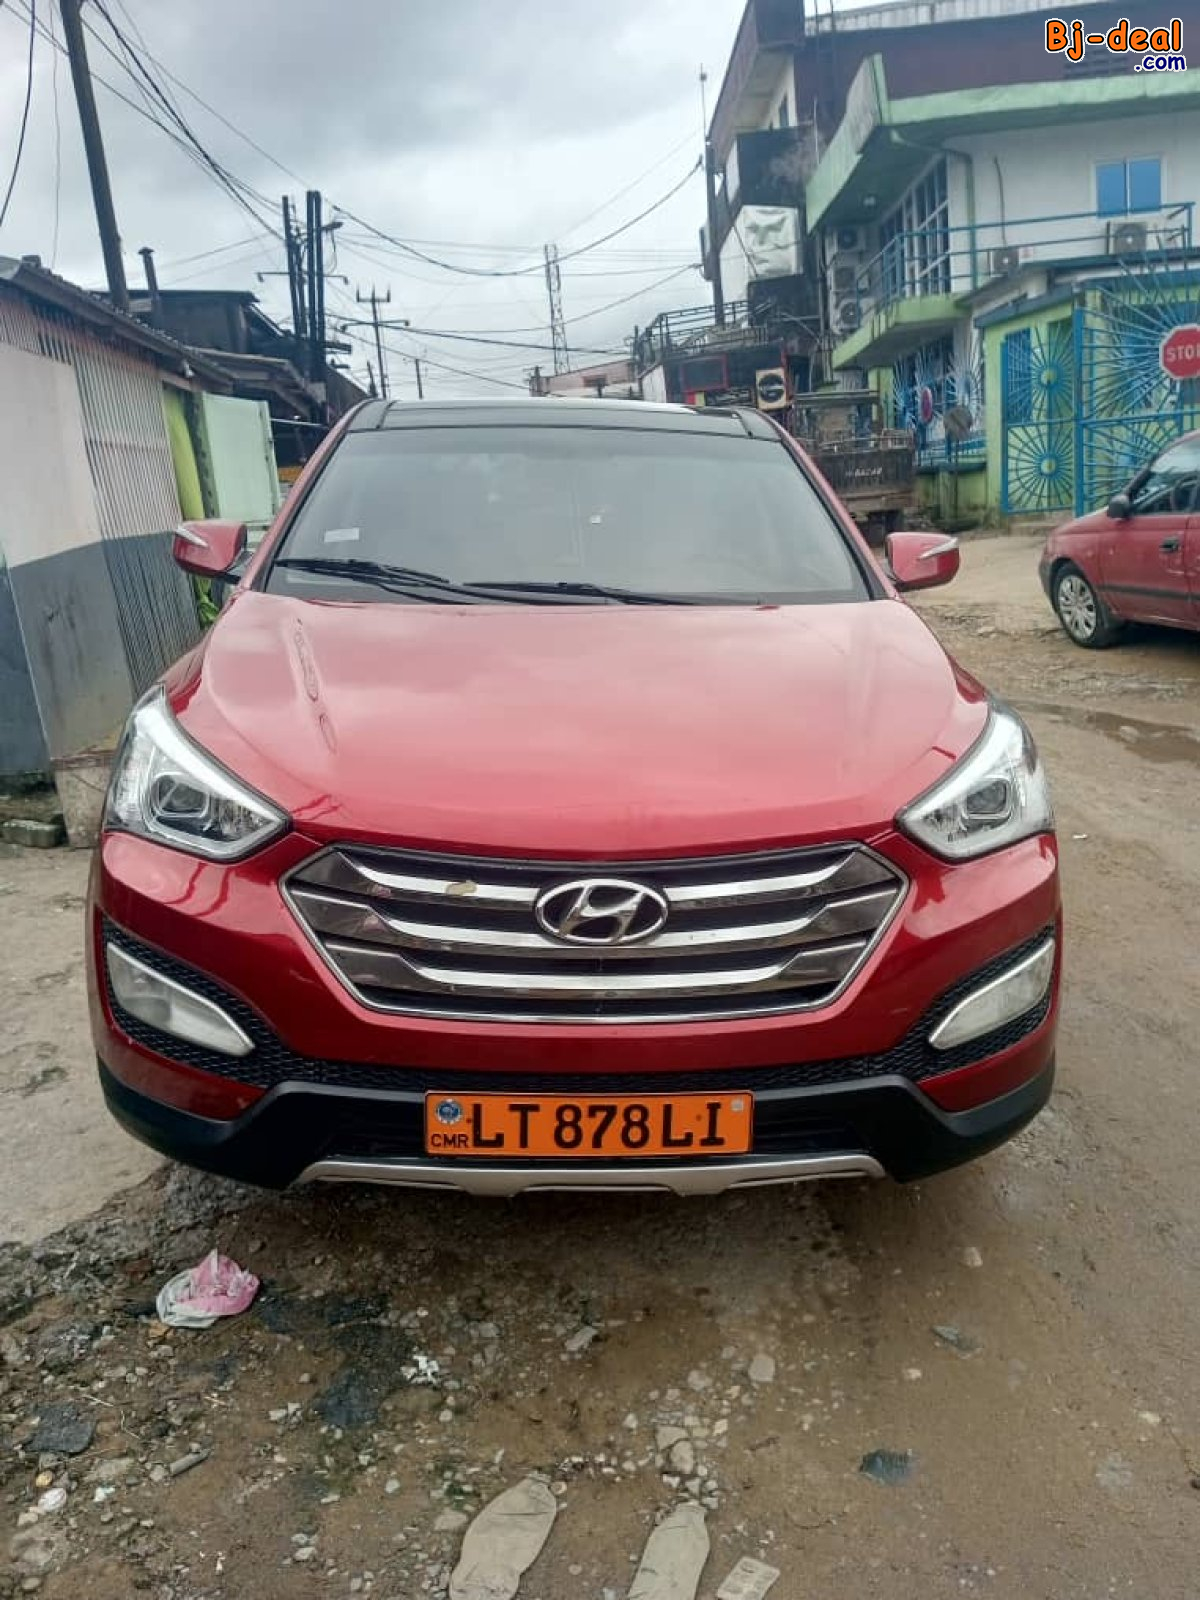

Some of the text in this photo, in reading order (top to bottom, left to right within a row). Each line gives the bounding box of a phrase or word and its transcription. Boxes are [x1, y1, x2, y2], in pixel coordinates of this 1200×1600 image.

[431, 1133, 469, 1148] CMR
[472, 1102, 726, 1149] LT 878 LI
